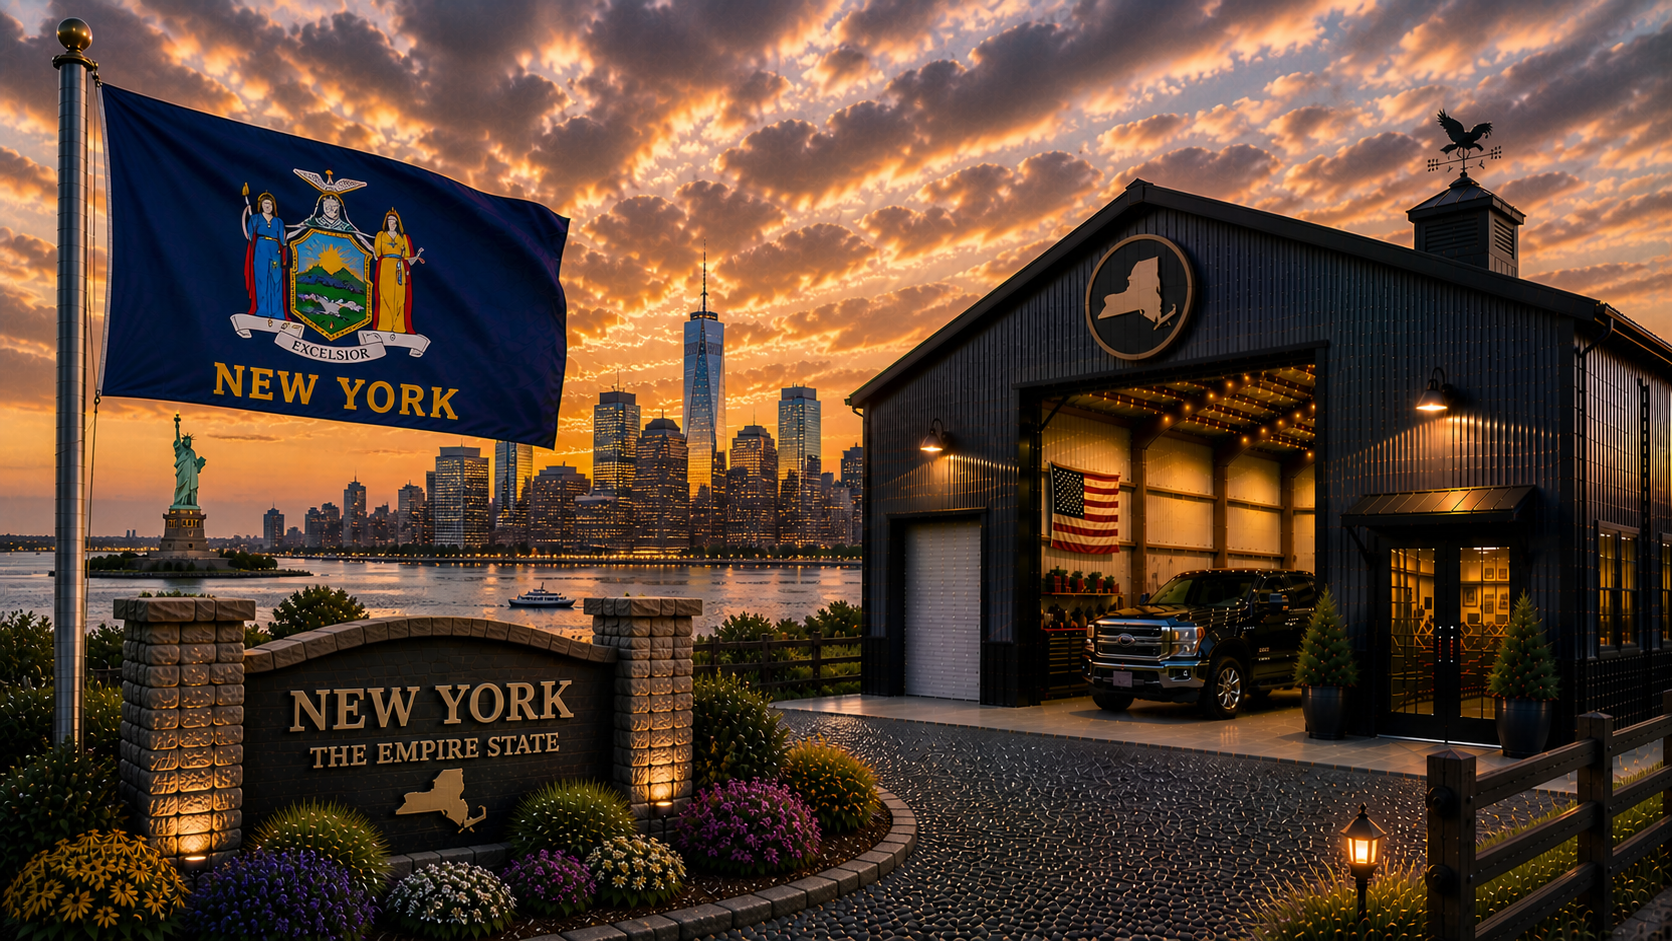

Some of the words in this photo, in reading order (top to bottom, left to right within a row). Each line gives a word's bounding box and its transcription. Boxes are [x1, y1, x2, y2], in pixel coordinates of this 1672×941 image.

[292, 340, 370, 361] EXCELSIOR
[213, 362, 319, 405] NEW
[336, 377, 459, 420] YORK
[289, 686, 421, 732] NEW
[435, 679, 575, 724] YORK
[309, 744, 368, 769] THE
[376, 737, 480, 765] EMPIRE
[487, 732, 560, 758] STATE
